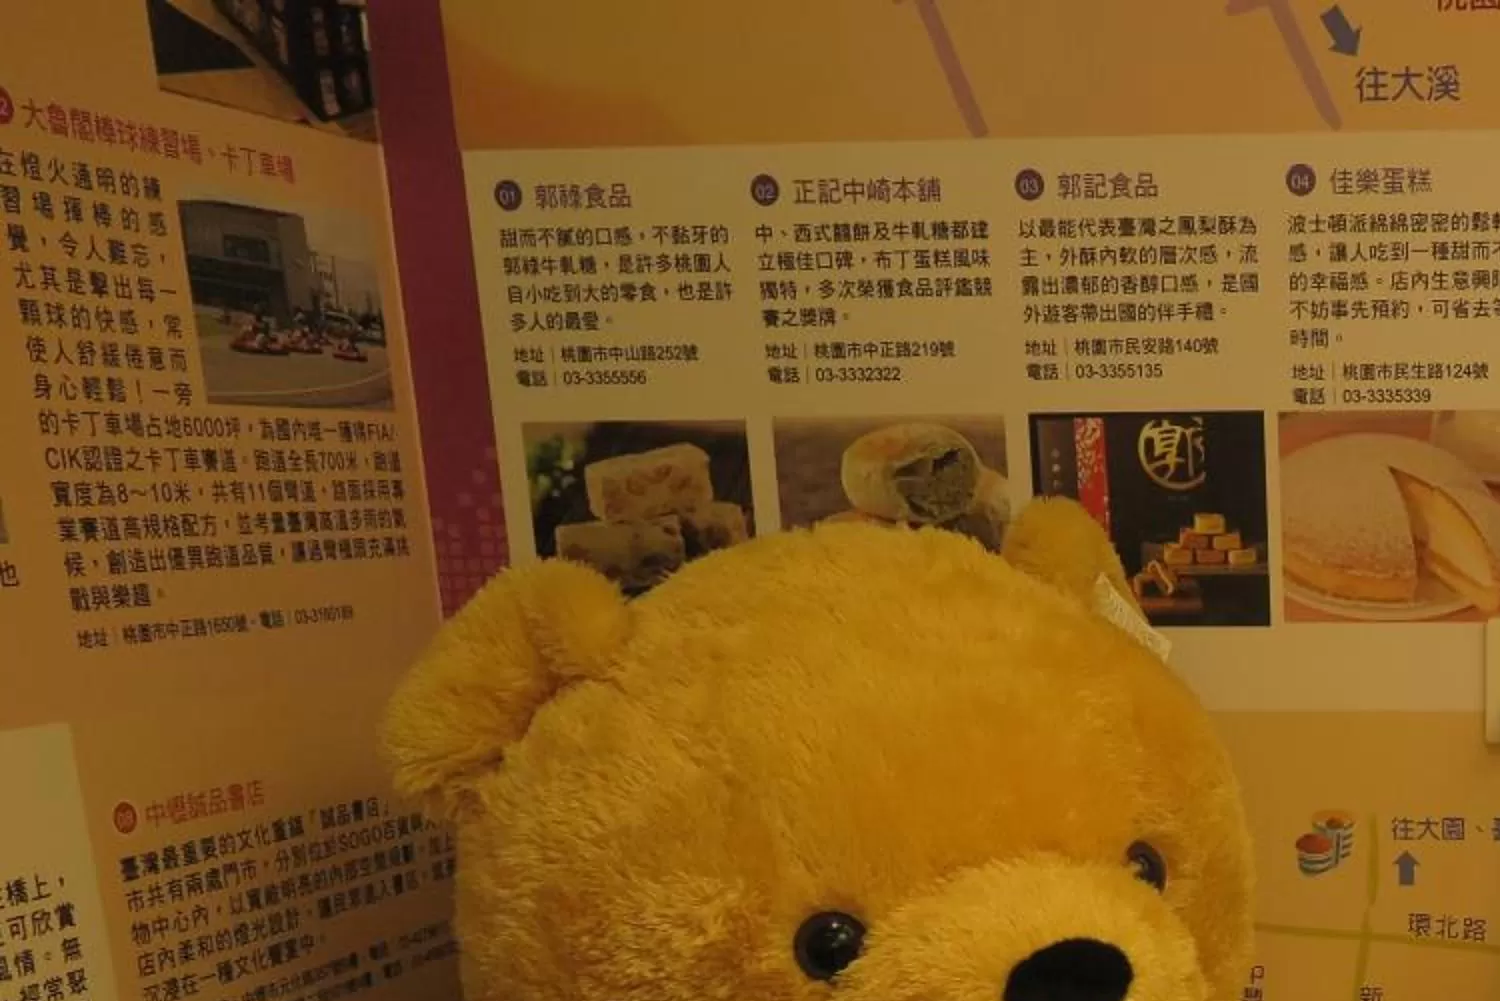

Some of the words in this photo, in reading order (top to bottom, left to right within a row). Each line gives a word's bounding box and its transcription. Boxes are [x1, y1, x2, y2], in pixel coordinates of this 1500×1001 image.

[1354, 63, 1461, 103] 往大溪
[1057, 172, 1158, 199] 郭記食品
[1330, 168, 1432, 195] 佳樂蛋糕
[0, 873, 64, 909] 橋上，
[0, 902, 76, 948] 可欣賞
[1408, 913, 1488, 942] 環北路
